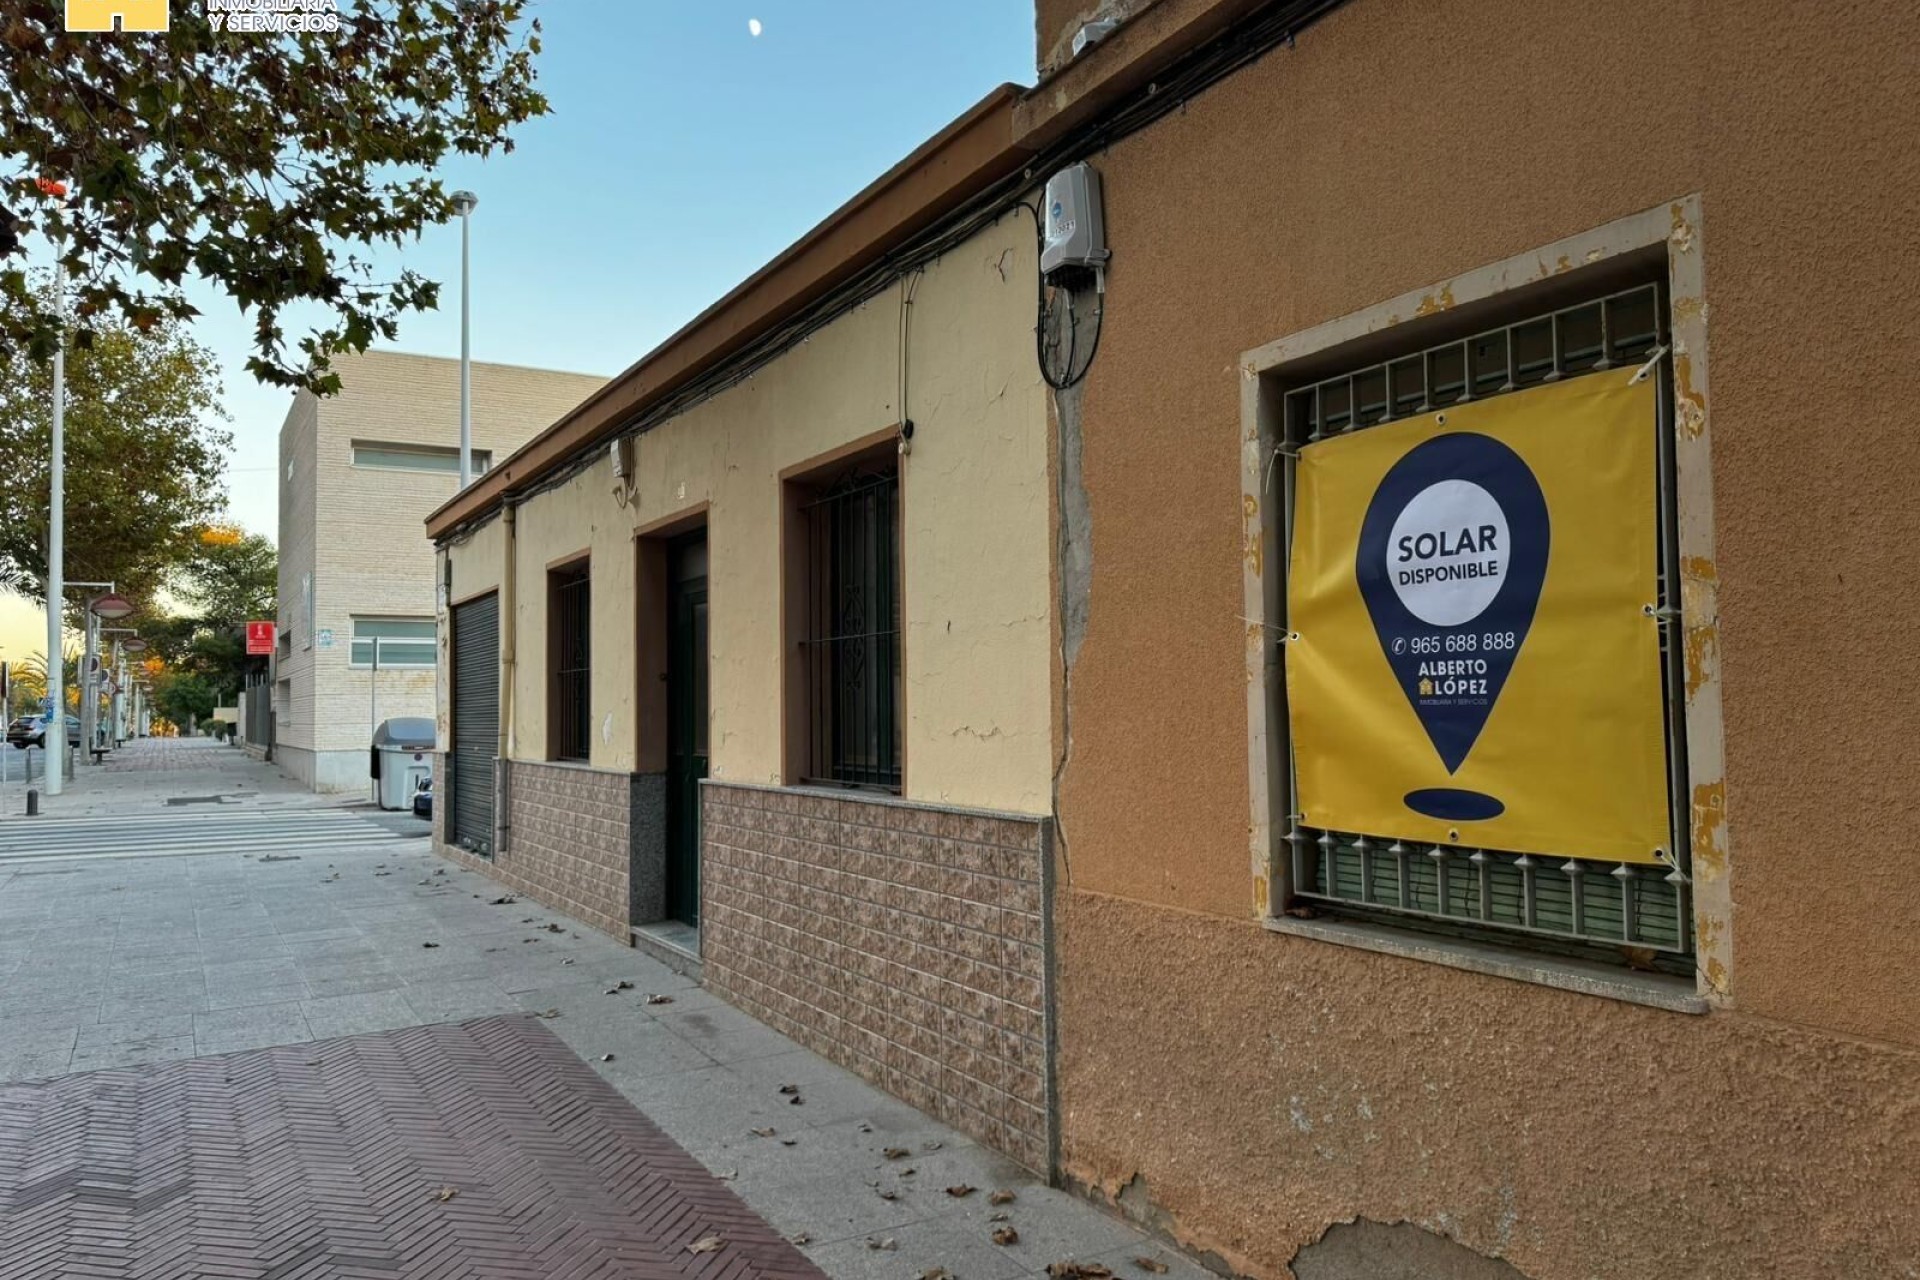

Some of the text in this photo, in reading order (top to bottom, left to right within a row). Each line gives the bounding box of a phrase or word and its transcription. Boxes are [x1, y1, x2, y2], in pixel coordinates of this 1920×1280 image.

[1398, 525, 1497, 562] SOLAR
[1398, 561, 1498, 586] DISPONIBLE
[1410, 631, 1515, 654] 965 688 888
[1418, 659, 1487, 676] ALBERTO
[1434, 676, 1488, 695] LÓPEZ
